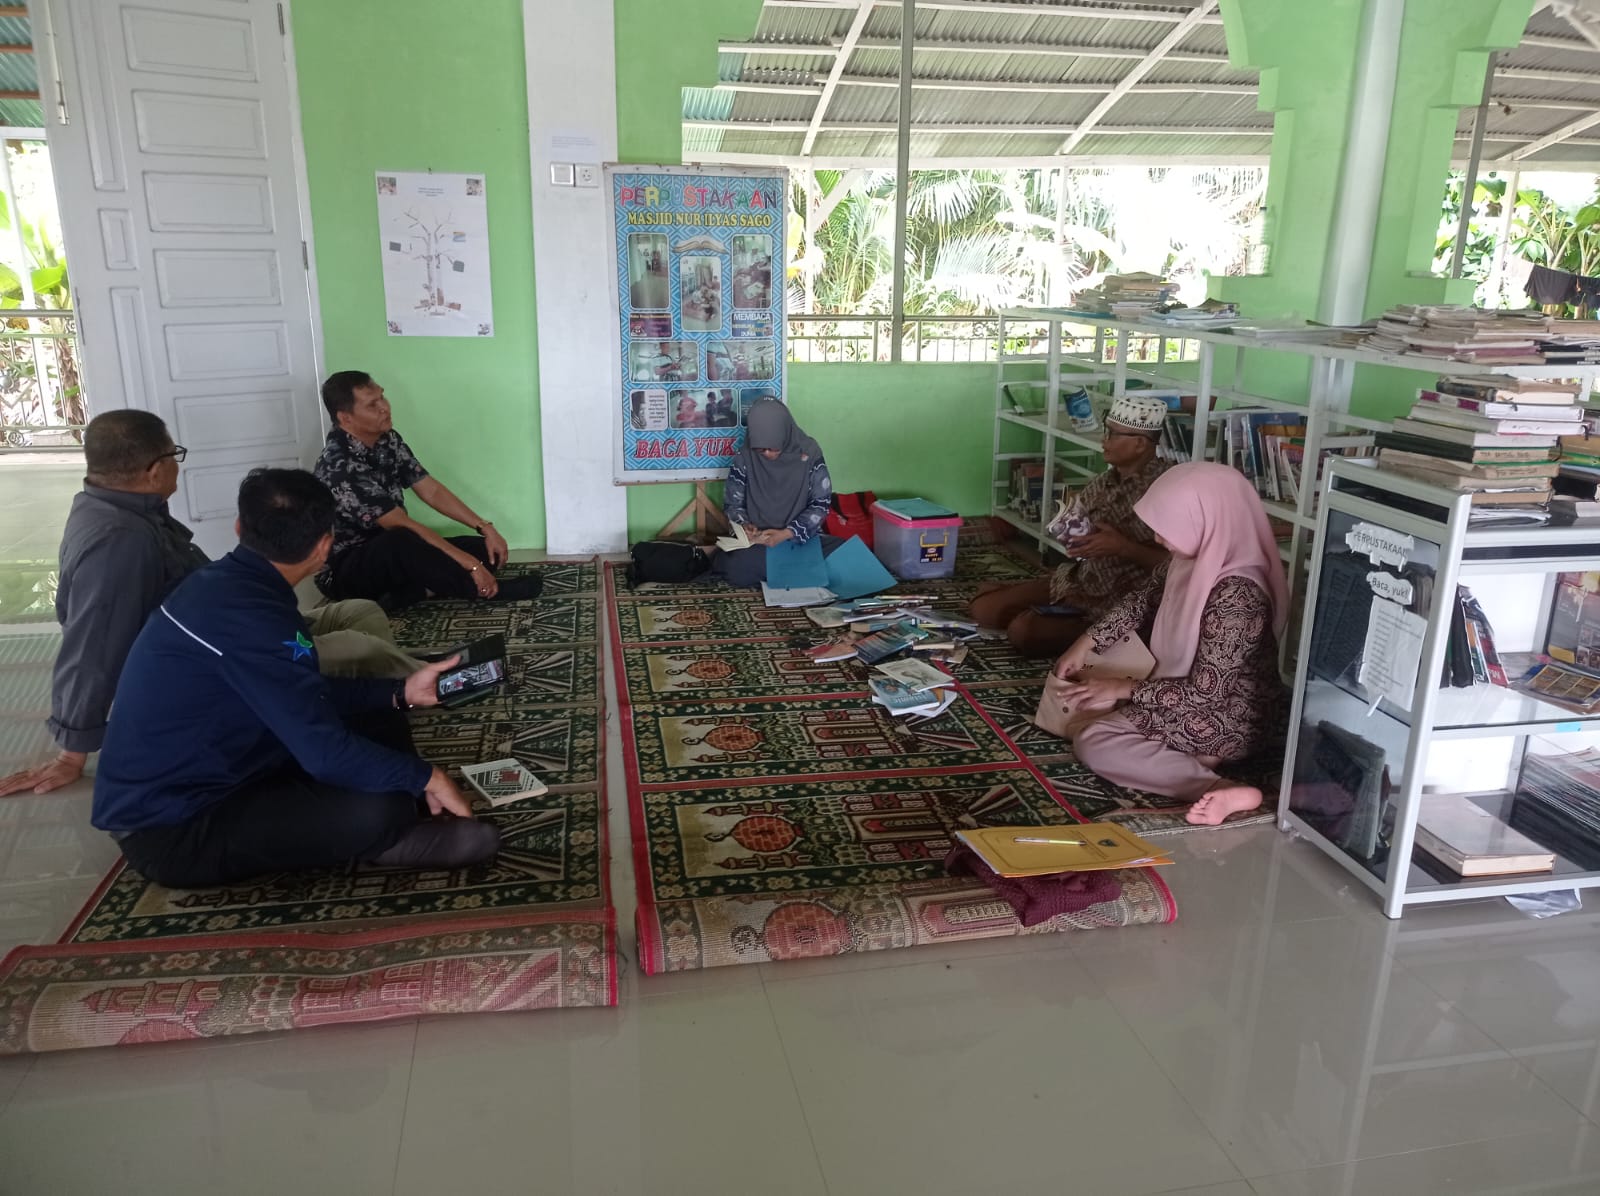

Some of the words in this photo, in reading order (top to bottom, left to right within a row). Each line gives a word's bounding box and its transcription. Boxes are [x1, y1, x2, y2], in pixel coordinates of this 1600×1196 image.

[620, 184, 777, 209] PERPUSTAKAAN
[628, 212, 673, 226] MASJID
[675, 212, 700, 226] NUR
[704, 213, 737, 227] ILYAS
[739, 213, 772, 227] SAGO
[733, 313, 771, 321] MEMBACA
[634, 439, 689, 459] BACA
[694, 437, 738, 457] YUK
